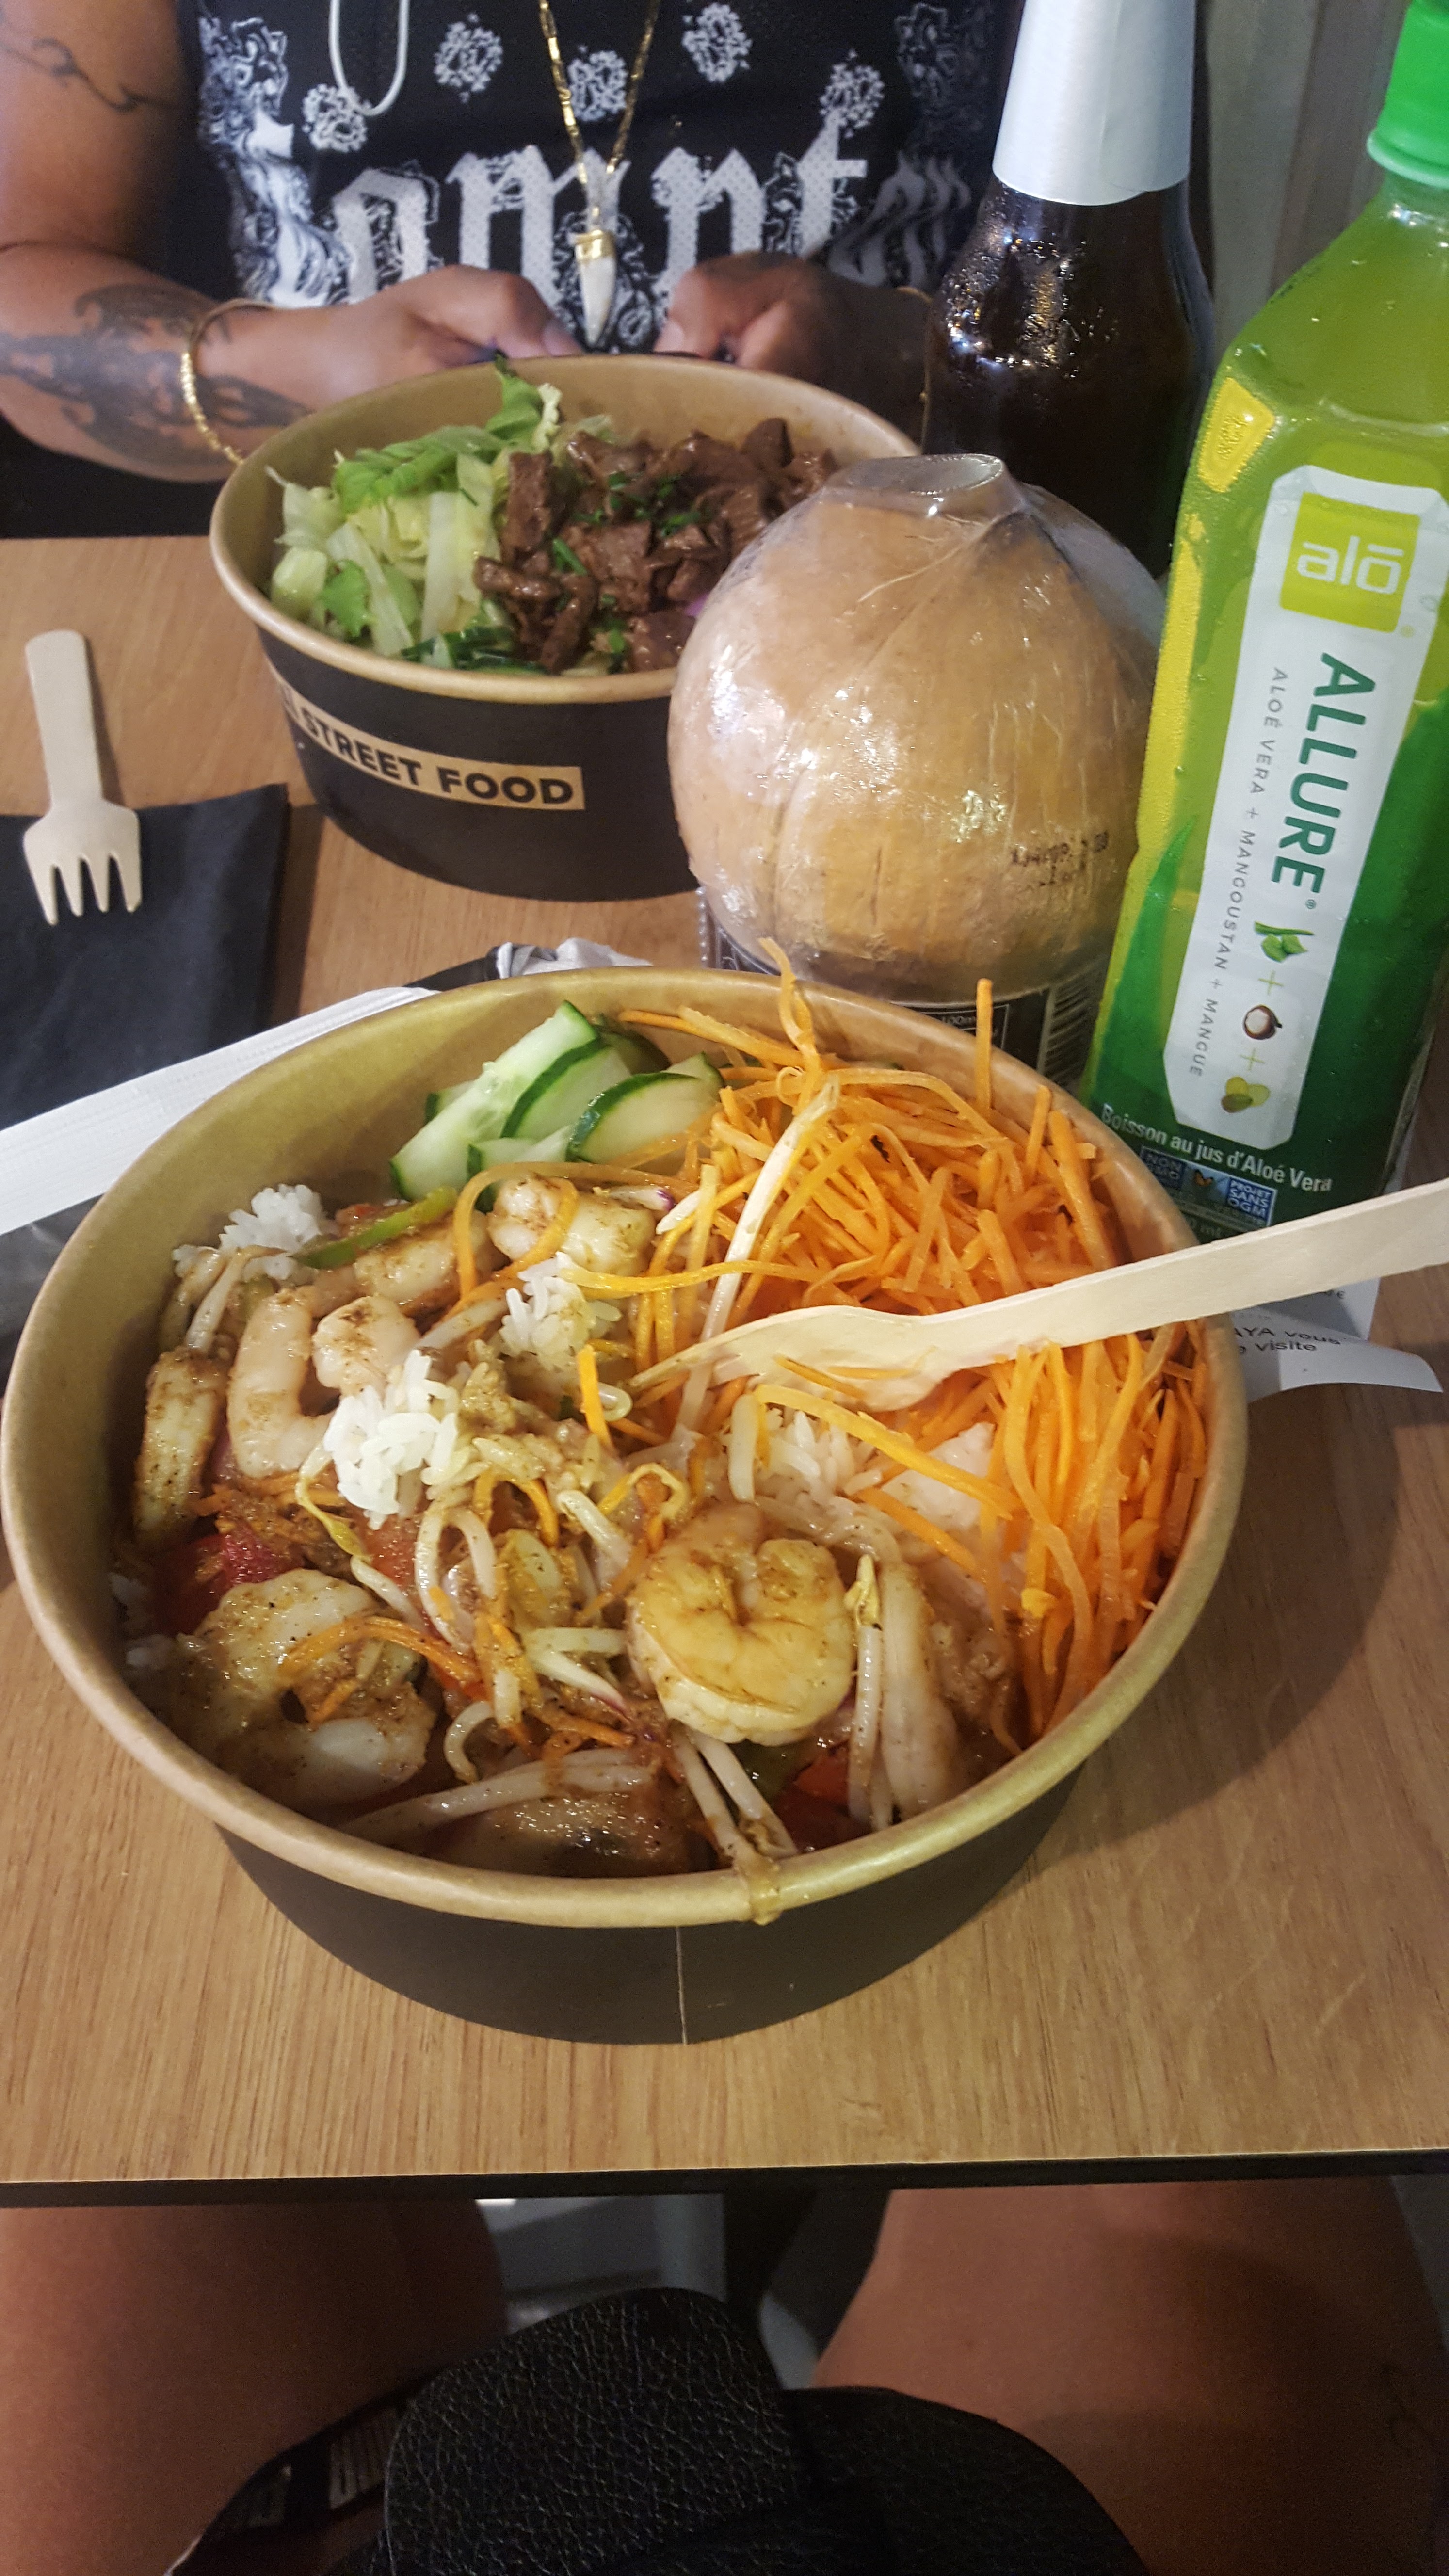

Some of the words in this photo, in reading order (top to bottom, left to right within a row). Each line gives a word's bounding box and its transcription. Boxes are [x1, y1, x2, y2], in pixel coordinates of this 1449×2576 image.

[1264, 667, 1288, 728] ALOÉ
[302, 708, 421, 786] STREET
[436, 766, 574, 805] FOOD
[1250, 740, 1275, 793] VERA
[1246, 807, 1259, 820] +
[1214, 830, 1256, 969] MANGOUSTAN
[1190, 999, 1219, 1077] MANGUE
[1101, 1103, 1167, 1145] Boisson
[1170, 1135, 1193, 1153] au
[1194, 1139, 1224, 1163] jus
[1289, 1167, 1333, 1192] Vera
[1229, 1188, 1269, 1208] SANS
[1230, 1179, 1272, 1198] PROJET
[1227, 1197, 1266, 1217] OGM
[1255, 1340, 1317, 1351] visite
[1285, 1331, 1341, 1345] vous
